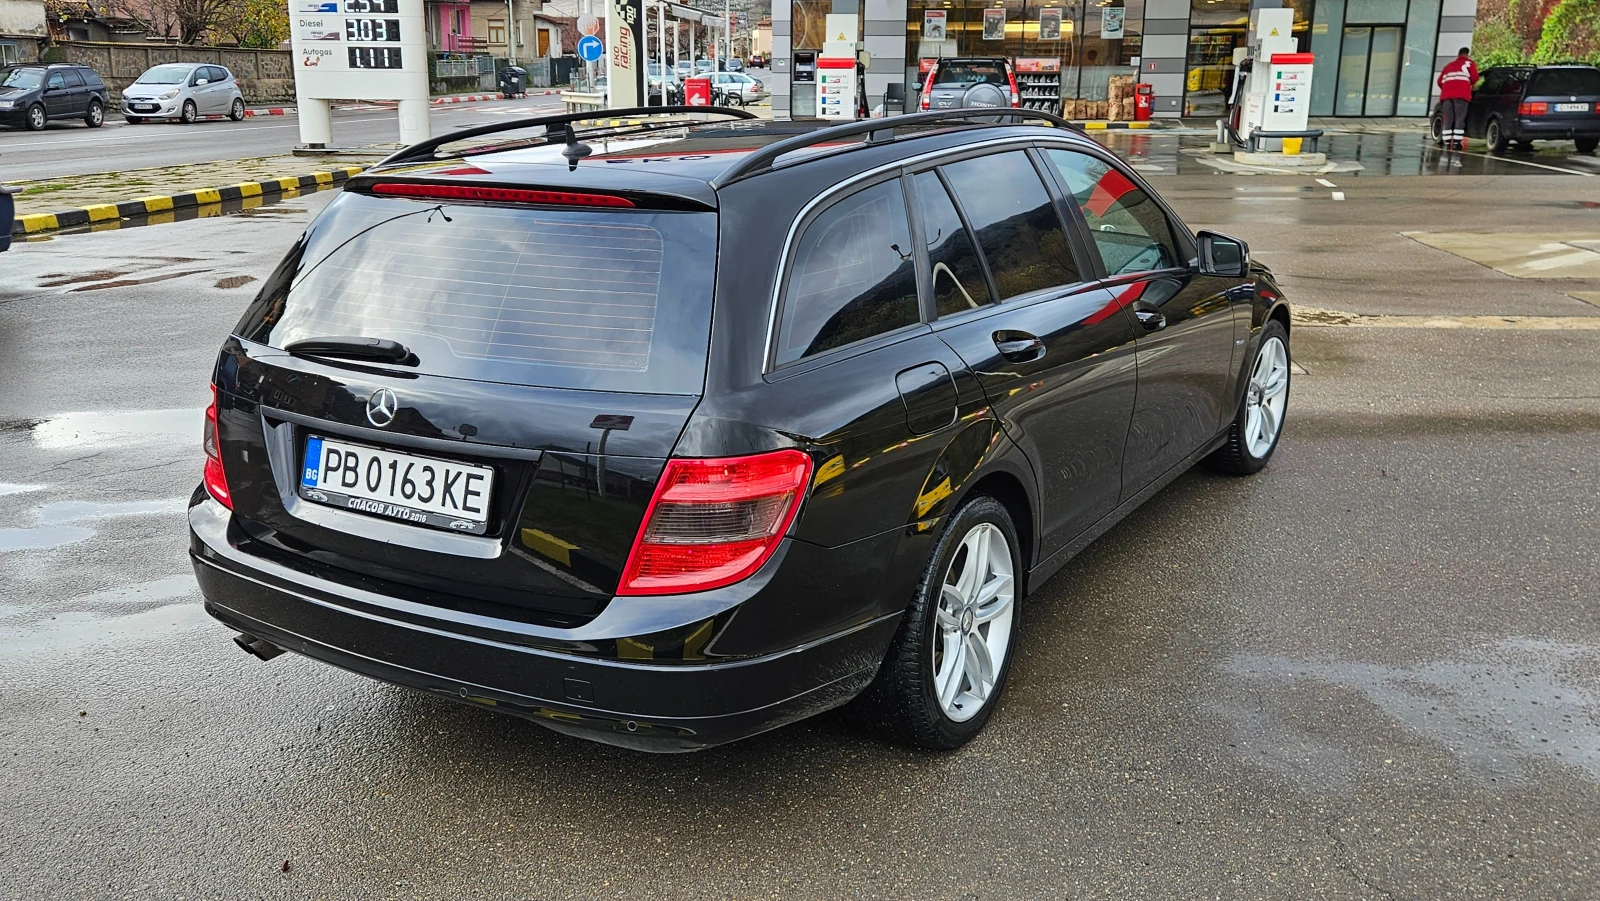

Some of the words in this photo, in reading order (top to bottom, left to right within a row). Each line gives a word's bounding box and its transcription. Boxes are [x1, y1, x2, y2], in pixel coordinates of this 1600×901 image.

[299, 19, 324, 28] Diesel
[626, 5, 635, 24] 100
[347, 19, 388, 41] 3.03
[302, 48, 333, 57] Autogas
[620, 26, 631, 70] racing
[355, 48, 389, 68] 1.11
[306, 467, 318, 480] BG
[347, 497, 385, 514] СПАСОВ
[385, 504, 410, 519] АУТО
[410, 512, 428, 523] 2016
